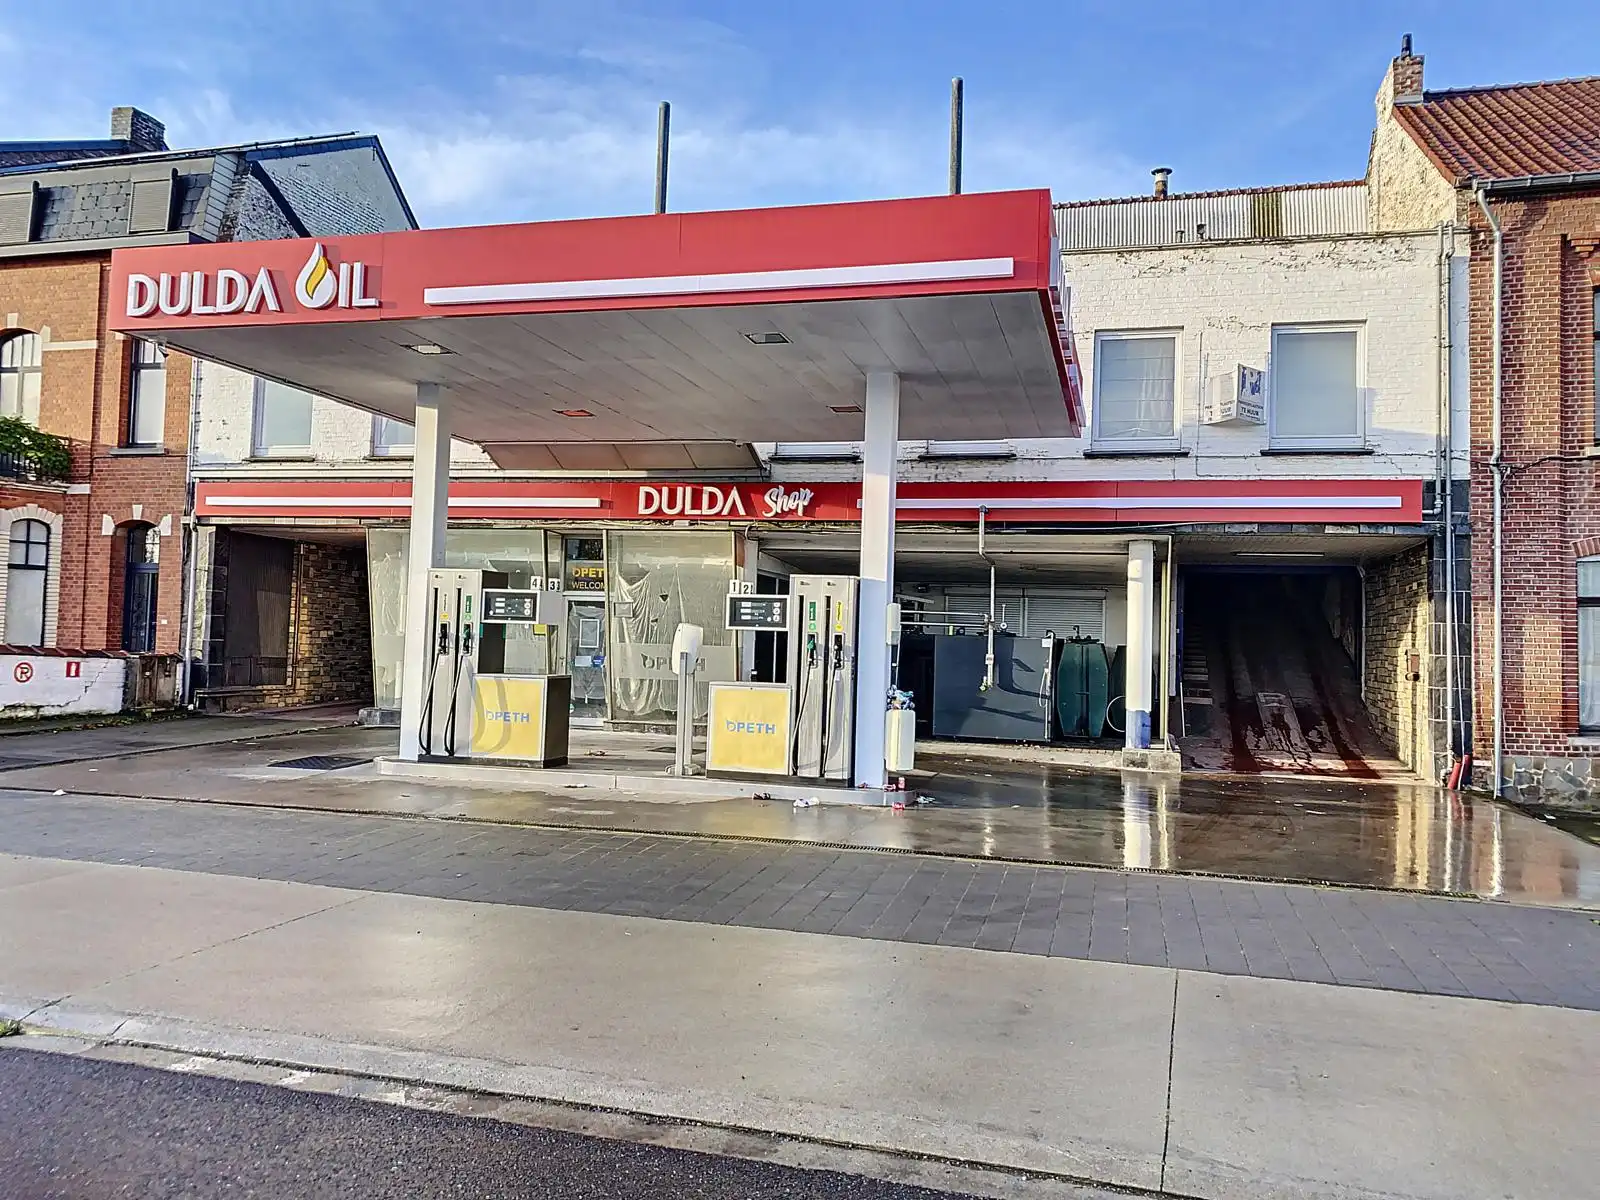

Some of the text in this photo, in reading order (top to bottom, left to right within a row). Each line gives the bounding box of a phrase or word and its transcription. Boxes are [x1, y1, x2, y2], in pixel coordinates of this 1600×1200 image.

[125, 266, 281, 316] DULDA
[637, 485, 814, 518] DULDA Shop
[550, 581, 556, 590] 3
[743, 584, 749, 594] 2
[640, 653, 706, 671] OPH
